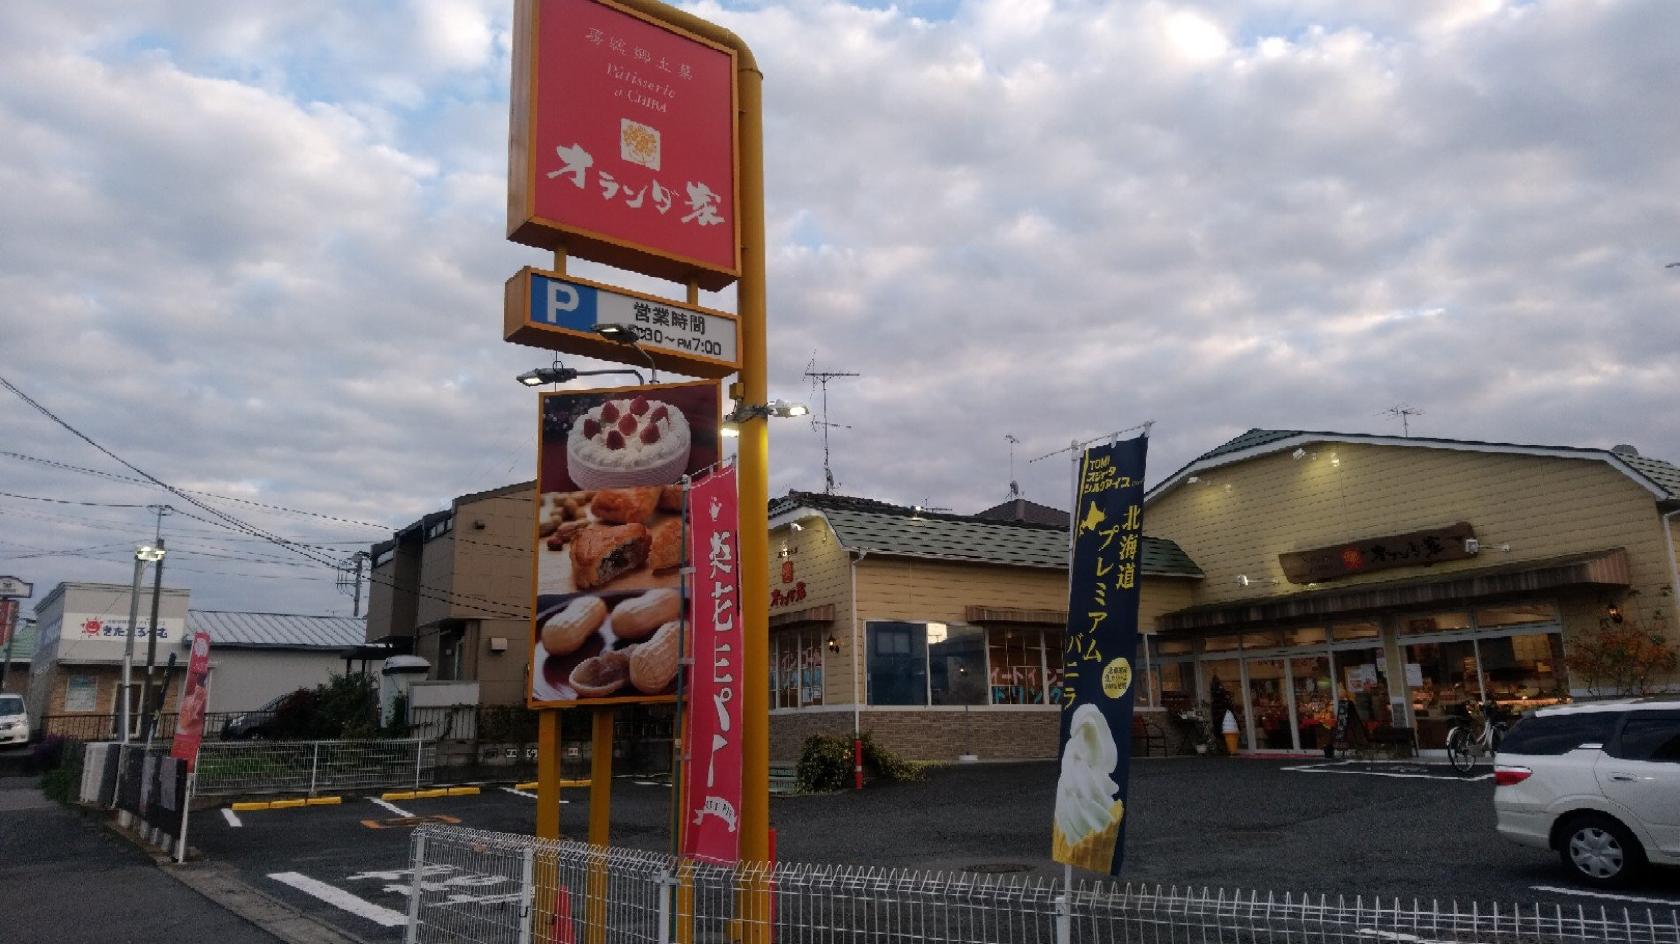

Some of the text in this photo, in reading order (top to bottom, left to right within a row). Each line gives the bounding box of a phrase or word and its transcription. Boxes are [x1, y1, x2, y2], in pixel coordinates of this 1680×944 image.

[546, 143, 726, 226] オランダ家
[547, 280, 579, 323] P
[634, 302, 706, 335] 営業時間
[1116, 505, 1141, 590] 北海道
[1083, 524, 1120, 663] プレミアム
[1064, 632, 1085, 710] バニラ
